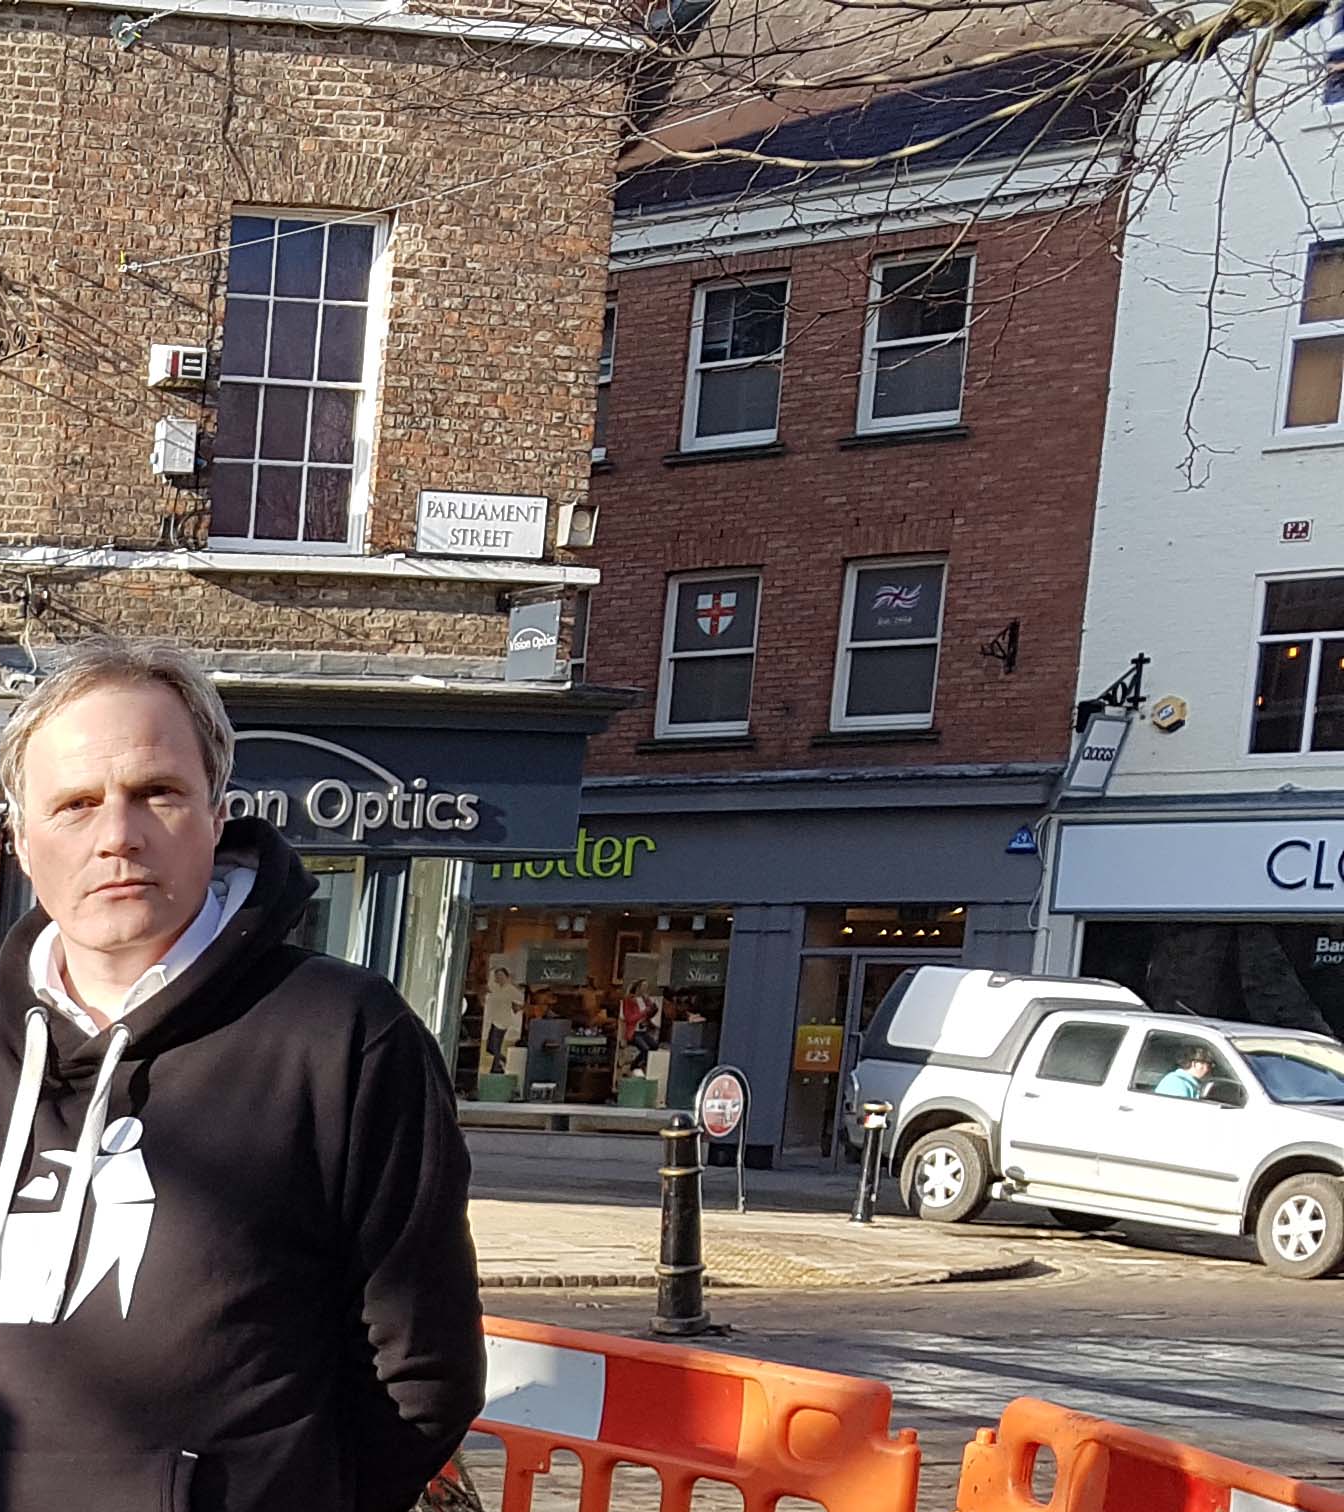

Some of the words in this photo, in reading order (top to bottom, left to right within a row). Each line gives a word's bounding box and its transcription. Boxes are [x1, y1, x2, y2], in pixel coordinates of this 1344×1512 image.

[426, 501, 542, 523] PARLIAMENT
[450, 528, 513, 548] STREET
[509, 635, 531, 651] Vision
[532, 632, 557, 650] Optics
[306, 778, 480, 841] Optics
[1266, 840, 1344, 890] CL
